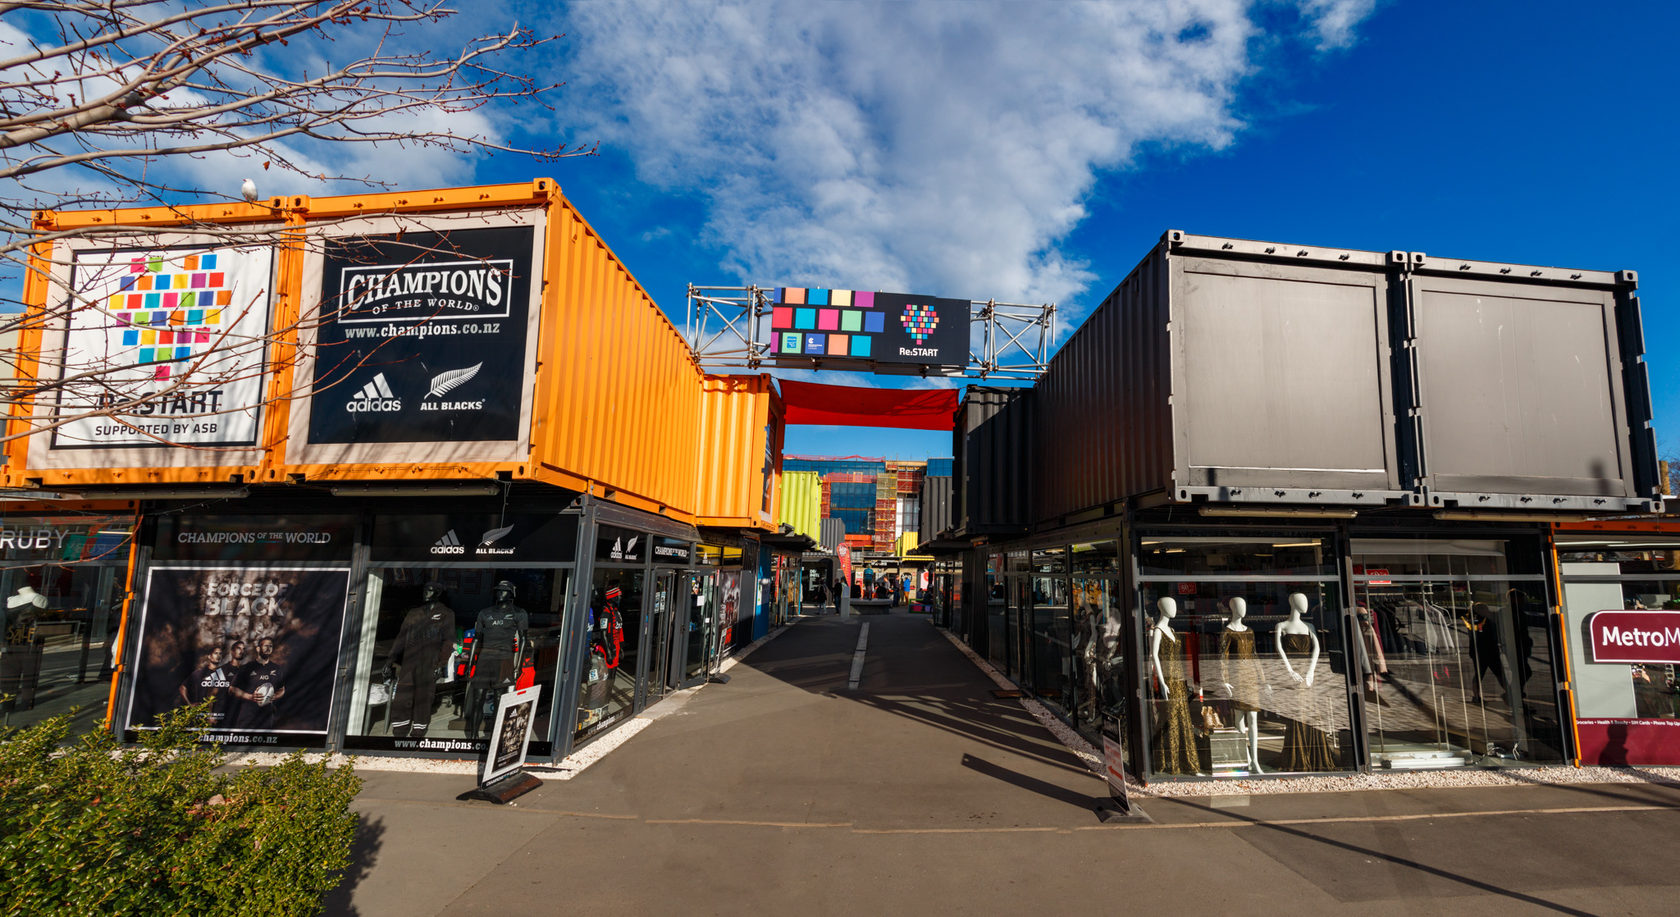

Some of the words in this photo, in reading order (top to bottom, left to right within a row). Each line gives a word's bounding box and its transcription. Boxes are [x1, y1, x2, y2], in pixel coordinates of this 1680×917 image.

[347, 268, 503, 311] CHAMPIONS
[372, 304, 388, 315] OF
[395, 300, 422, 310] THE
[428, 298, 473, 311] WORLD
[344, 322, 501, 340] www.champions.co.nz
[899, 347, 939, 357] Re:START
[346, 397, 402, 413] adidas
[420, 402, 438, 411] ALL
[441, 401, 483, 411] BLACKS
[95, 424, 169, 436] SUPPORTED
[173, 424, 189, 434] BY
[192, 423, 218, 434] ASB
[0, 528, 70, 549] RUBY
[177, 532, 255, 544] CHAMPIONS
[285, 532, 331, 544] WORLD
[430, 545, 465, 554] adidas
[207, 583, 262, 597] FORCE
[265, 583, 289, 597] OF
[204, 597, 285, 617] BLACK
[1602, 626, 1680, 647] MetroM
[201, 680, 231, 689] adidas
